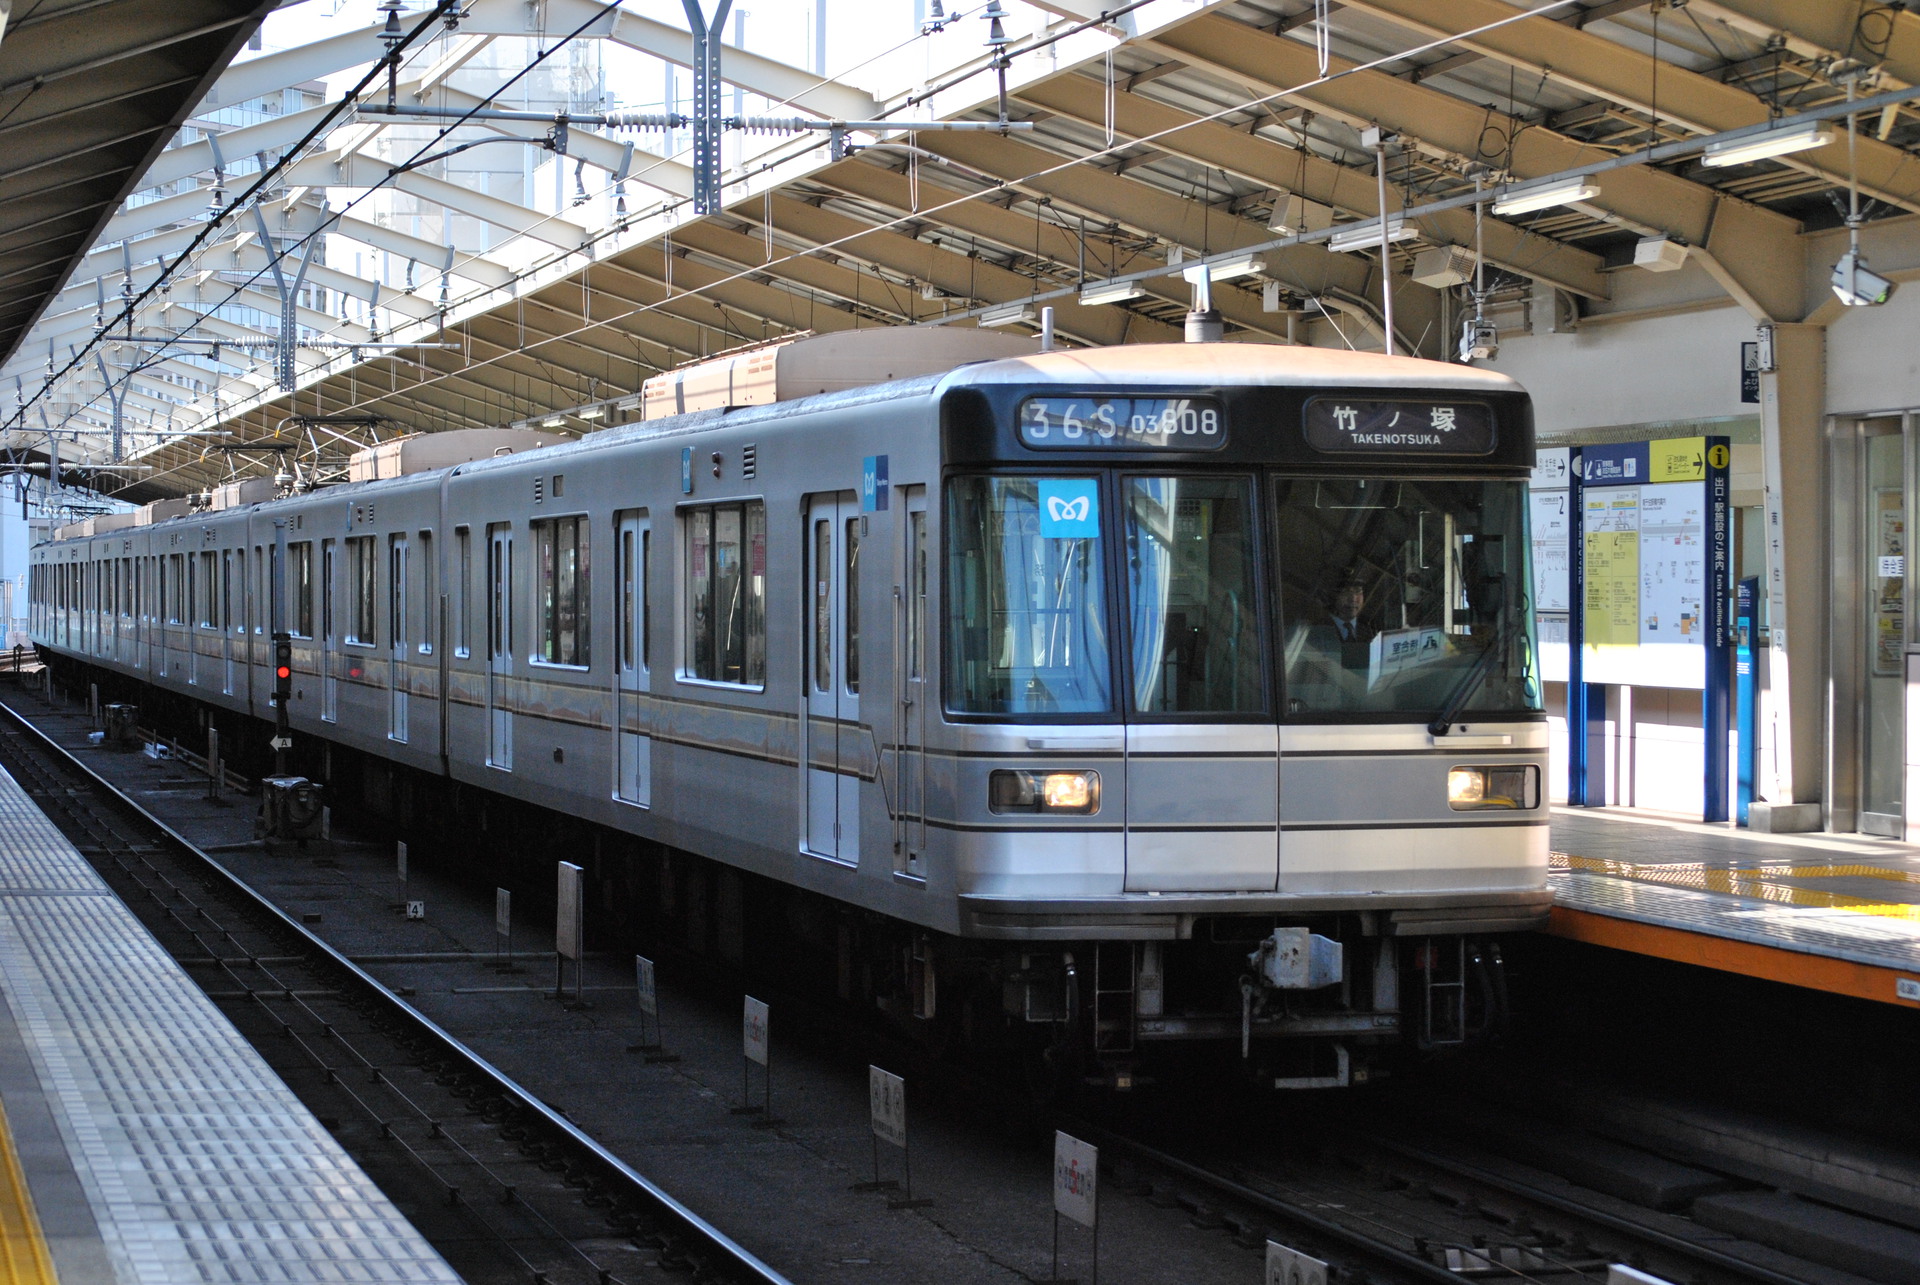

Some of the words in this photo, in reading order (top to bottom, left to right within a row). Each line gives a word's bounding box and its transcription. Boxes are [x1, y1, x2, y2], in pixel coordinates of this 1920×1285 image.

[1332, 405, 1457, 432] 竹ノ塚
[1351, 433, 1442, 445] TAKENOTSUKA
[281, 738, 288, 747] A
[412, 904, 419, 915] 4
